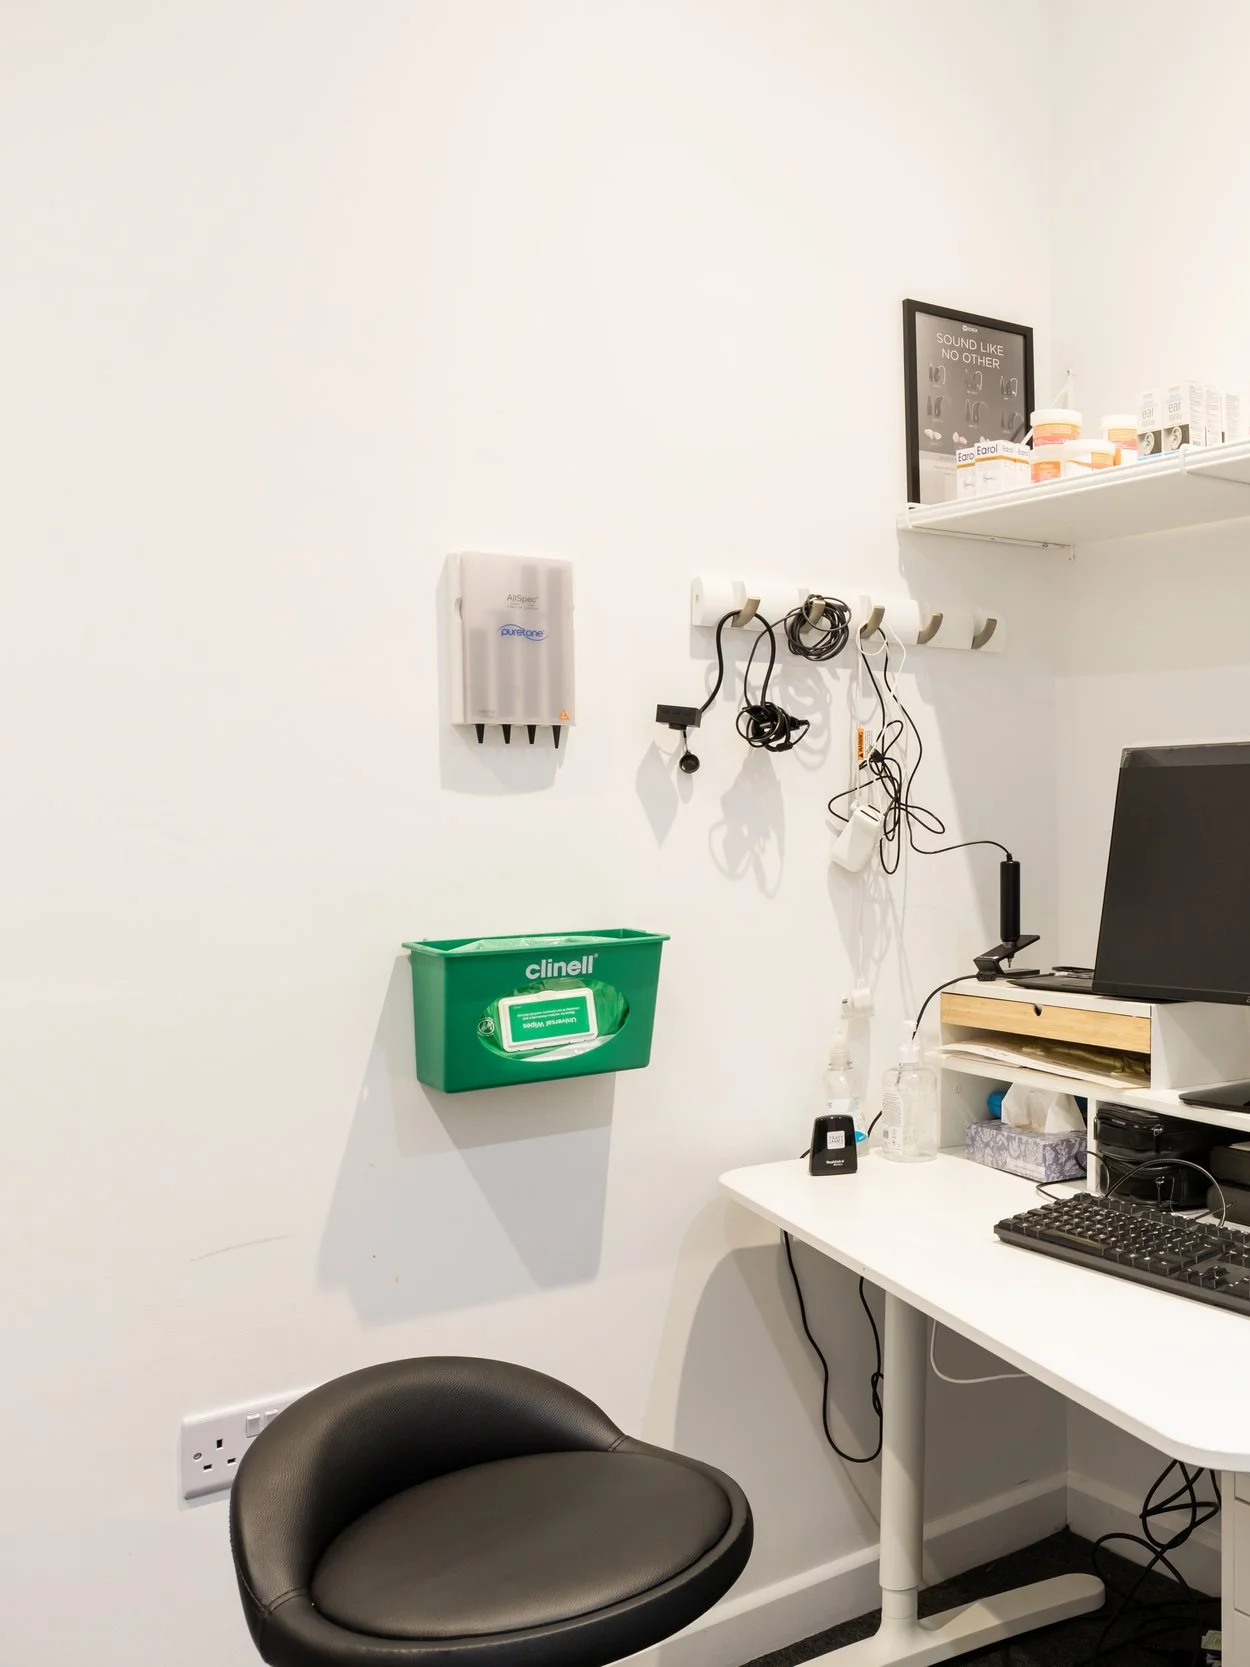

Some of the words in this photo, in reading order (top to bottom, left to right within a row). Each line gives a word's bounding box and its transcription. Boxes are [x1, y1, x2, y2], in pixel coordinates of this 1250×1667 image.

[936, 332, 978, 350] SOUND
[980, 341, 1004, 356] LIKE
[942, 348, 959, 360] NO
[962, 352, 1000, 369] OTHER
[1168, 402, 1181, 413] ear
[1142, 408, 1154, 419] ear
[976, 444, 998, 456] Earol
[958, 452, 975, 462] Earo
[506, 594, 537, 604] AllSpec
[501, 628, 544, 638] puretone
[526, 955, 594, 980] clinell
[546, 1017, 576, 1026] Universal
